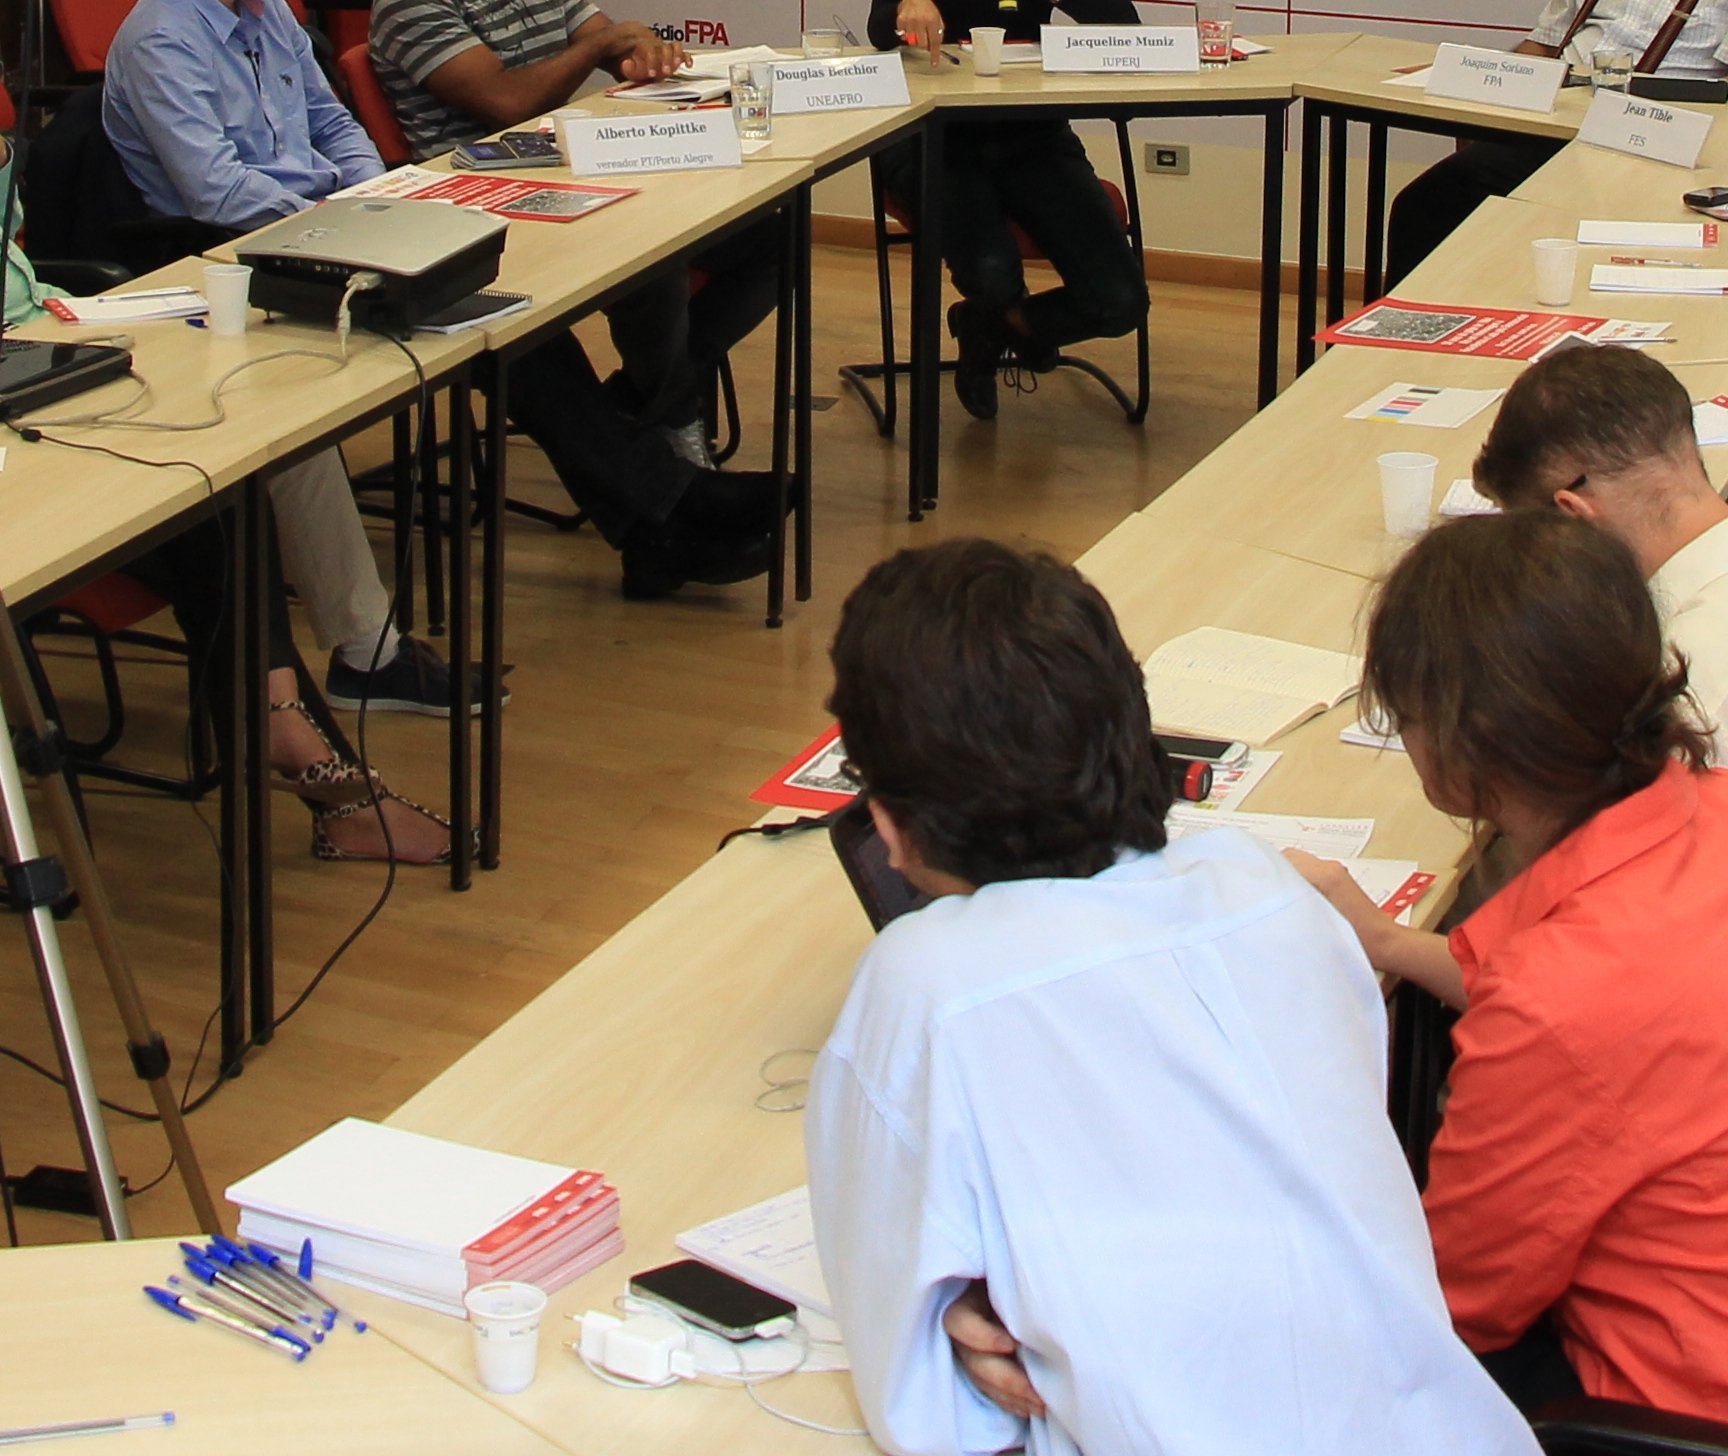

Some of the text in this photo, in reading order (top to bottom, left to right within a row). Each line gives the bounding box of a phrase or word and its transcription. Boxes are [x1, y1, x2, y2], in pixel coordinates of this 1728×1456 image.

[1066, 34, 1175, 50] Jacqueline Muniz
[1102, 56, 1142, 70] IUPERJ
[1459, 54, 1497, 73] Joaquim
[775, 67, 824, 81] Douglas
[1482, 74, 1503, 88] FPA
[806, 92, 864, 108] UNEAFRO
[1623, 101, 1649, 118] Jean
[595, 121, 708, 142] Alberto Kopittke
[1628, 133, 1647, 147] FES
[596, 151, 714, 170] vereador PT/Porto Alegre
